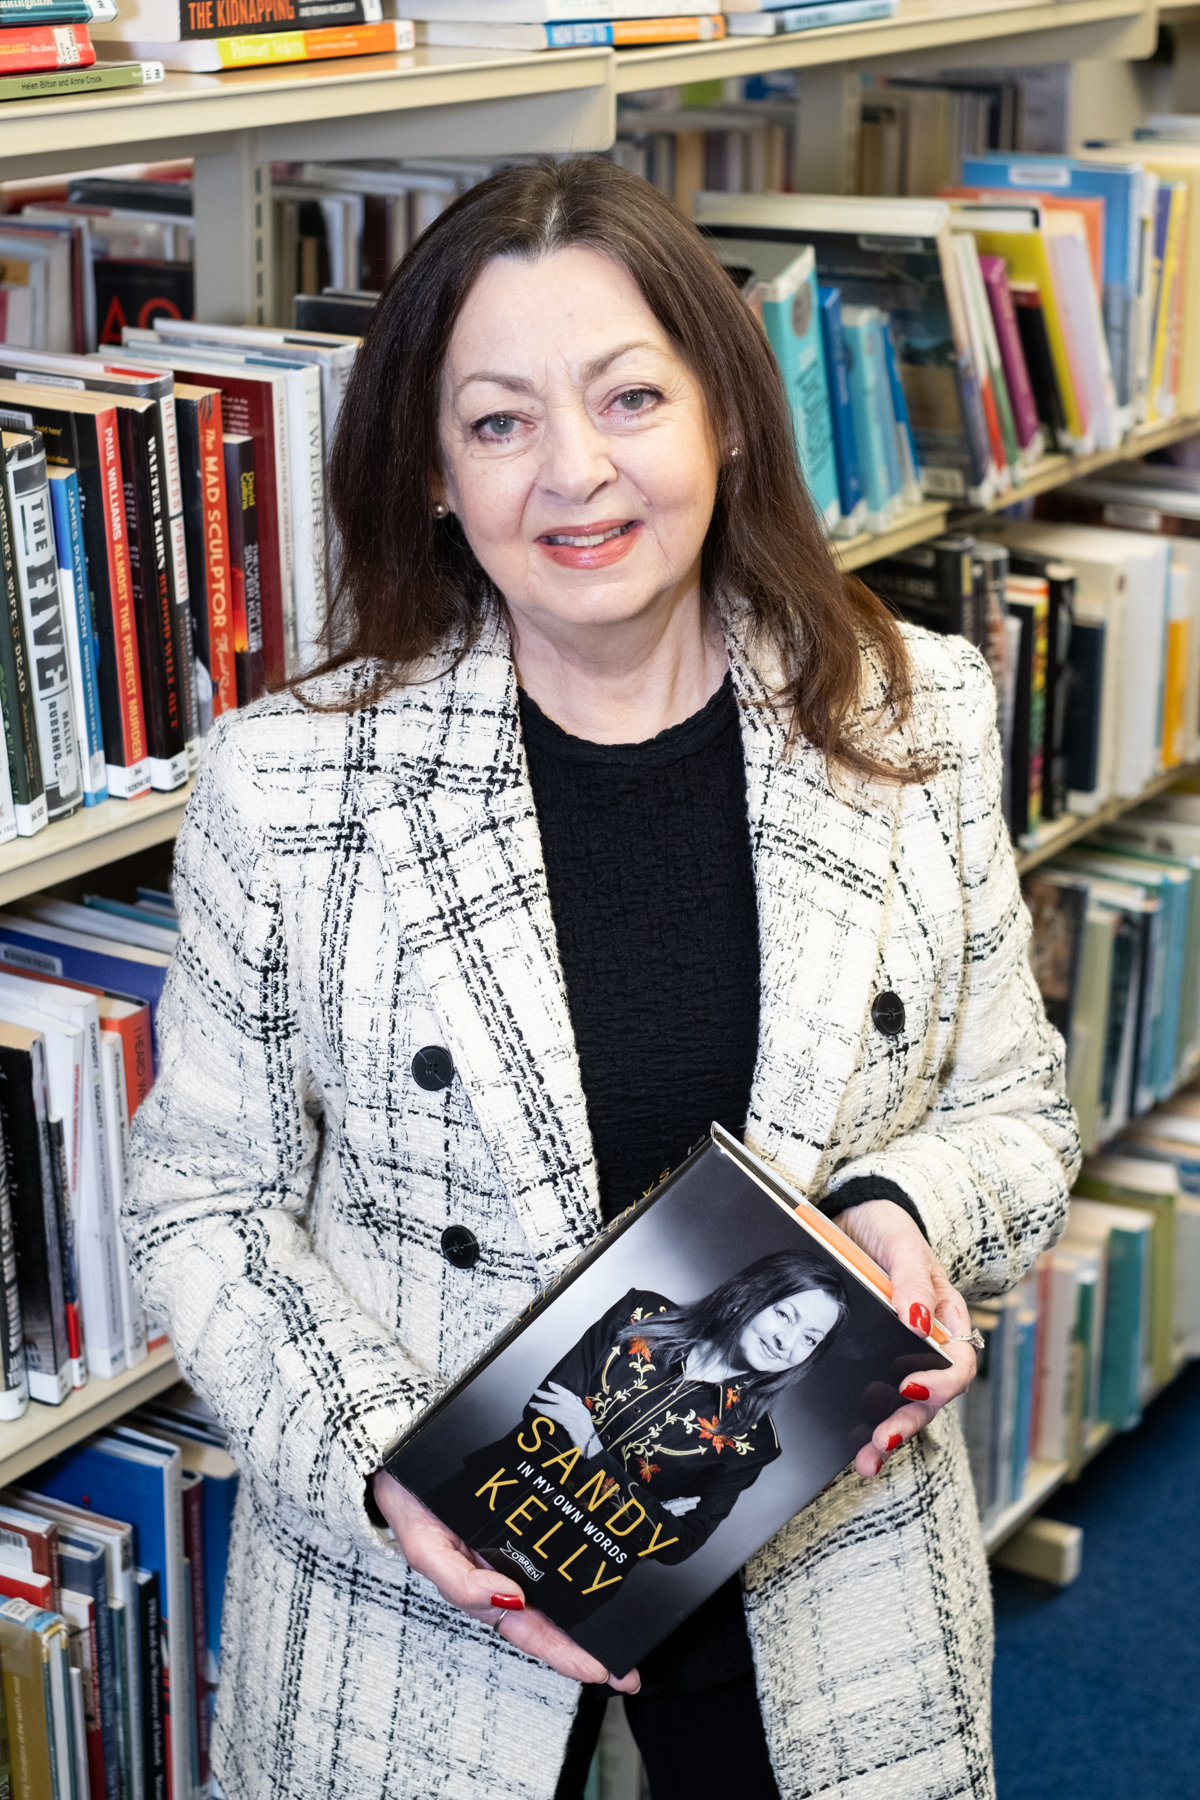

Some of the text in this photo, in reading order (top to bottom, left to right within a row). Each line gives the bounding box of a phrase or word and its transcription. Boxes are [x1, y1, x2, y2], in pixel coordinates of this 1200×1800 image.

[188, 0, 296, 31] THE KIDNAPPING
[21, 75, 103, 91] Helen Bilton and Anne Crook
[104, 426, 115, 467] PAUL
[106, 466, 123, 542] WILLIAMS
[164, 400, 189, 597] RELENTLESS PURSUIT
[240, 472, 249, 512] Collins
[247, 470, 256, 508] David
[205, 428, 227, 629] The MAD SCULPTOR
[26, 497, 69, 692] THE FIVE
[67, 488, 88, 640] JAMES PATTERSON
[113, 543, 128, 607] ALMOST
[147, 435, 179, 730] WALTER KIRN BLOOD WILL OUT
[119, 602, 132, 633] THE
[244, 543, 259, 654] SILVER KILLER
[7, 575, 18, 621] WIFE
[15, 642, 26, 693] DEAD
[122, 634, 137, 697] PERFECT
[48, 701, 63, 777] RUBENHO
[62, 710, 74, 757] HALLIE
[127, 697, 143, 760] MURDER
[90, 1021, 99, 1069] DIVERSITY
[134, 1033, 147, 1076] HEARD
[94, 1083, 103, 1129] EQUALITY
[516, 1460, 628, 1565] IN MY OWN WORDS
[517, 1416, 680, 1557] SANDY
[474, 1467, 624, 1596] KELLY
[510, 1551, 540, 1580] O'BRIEN
